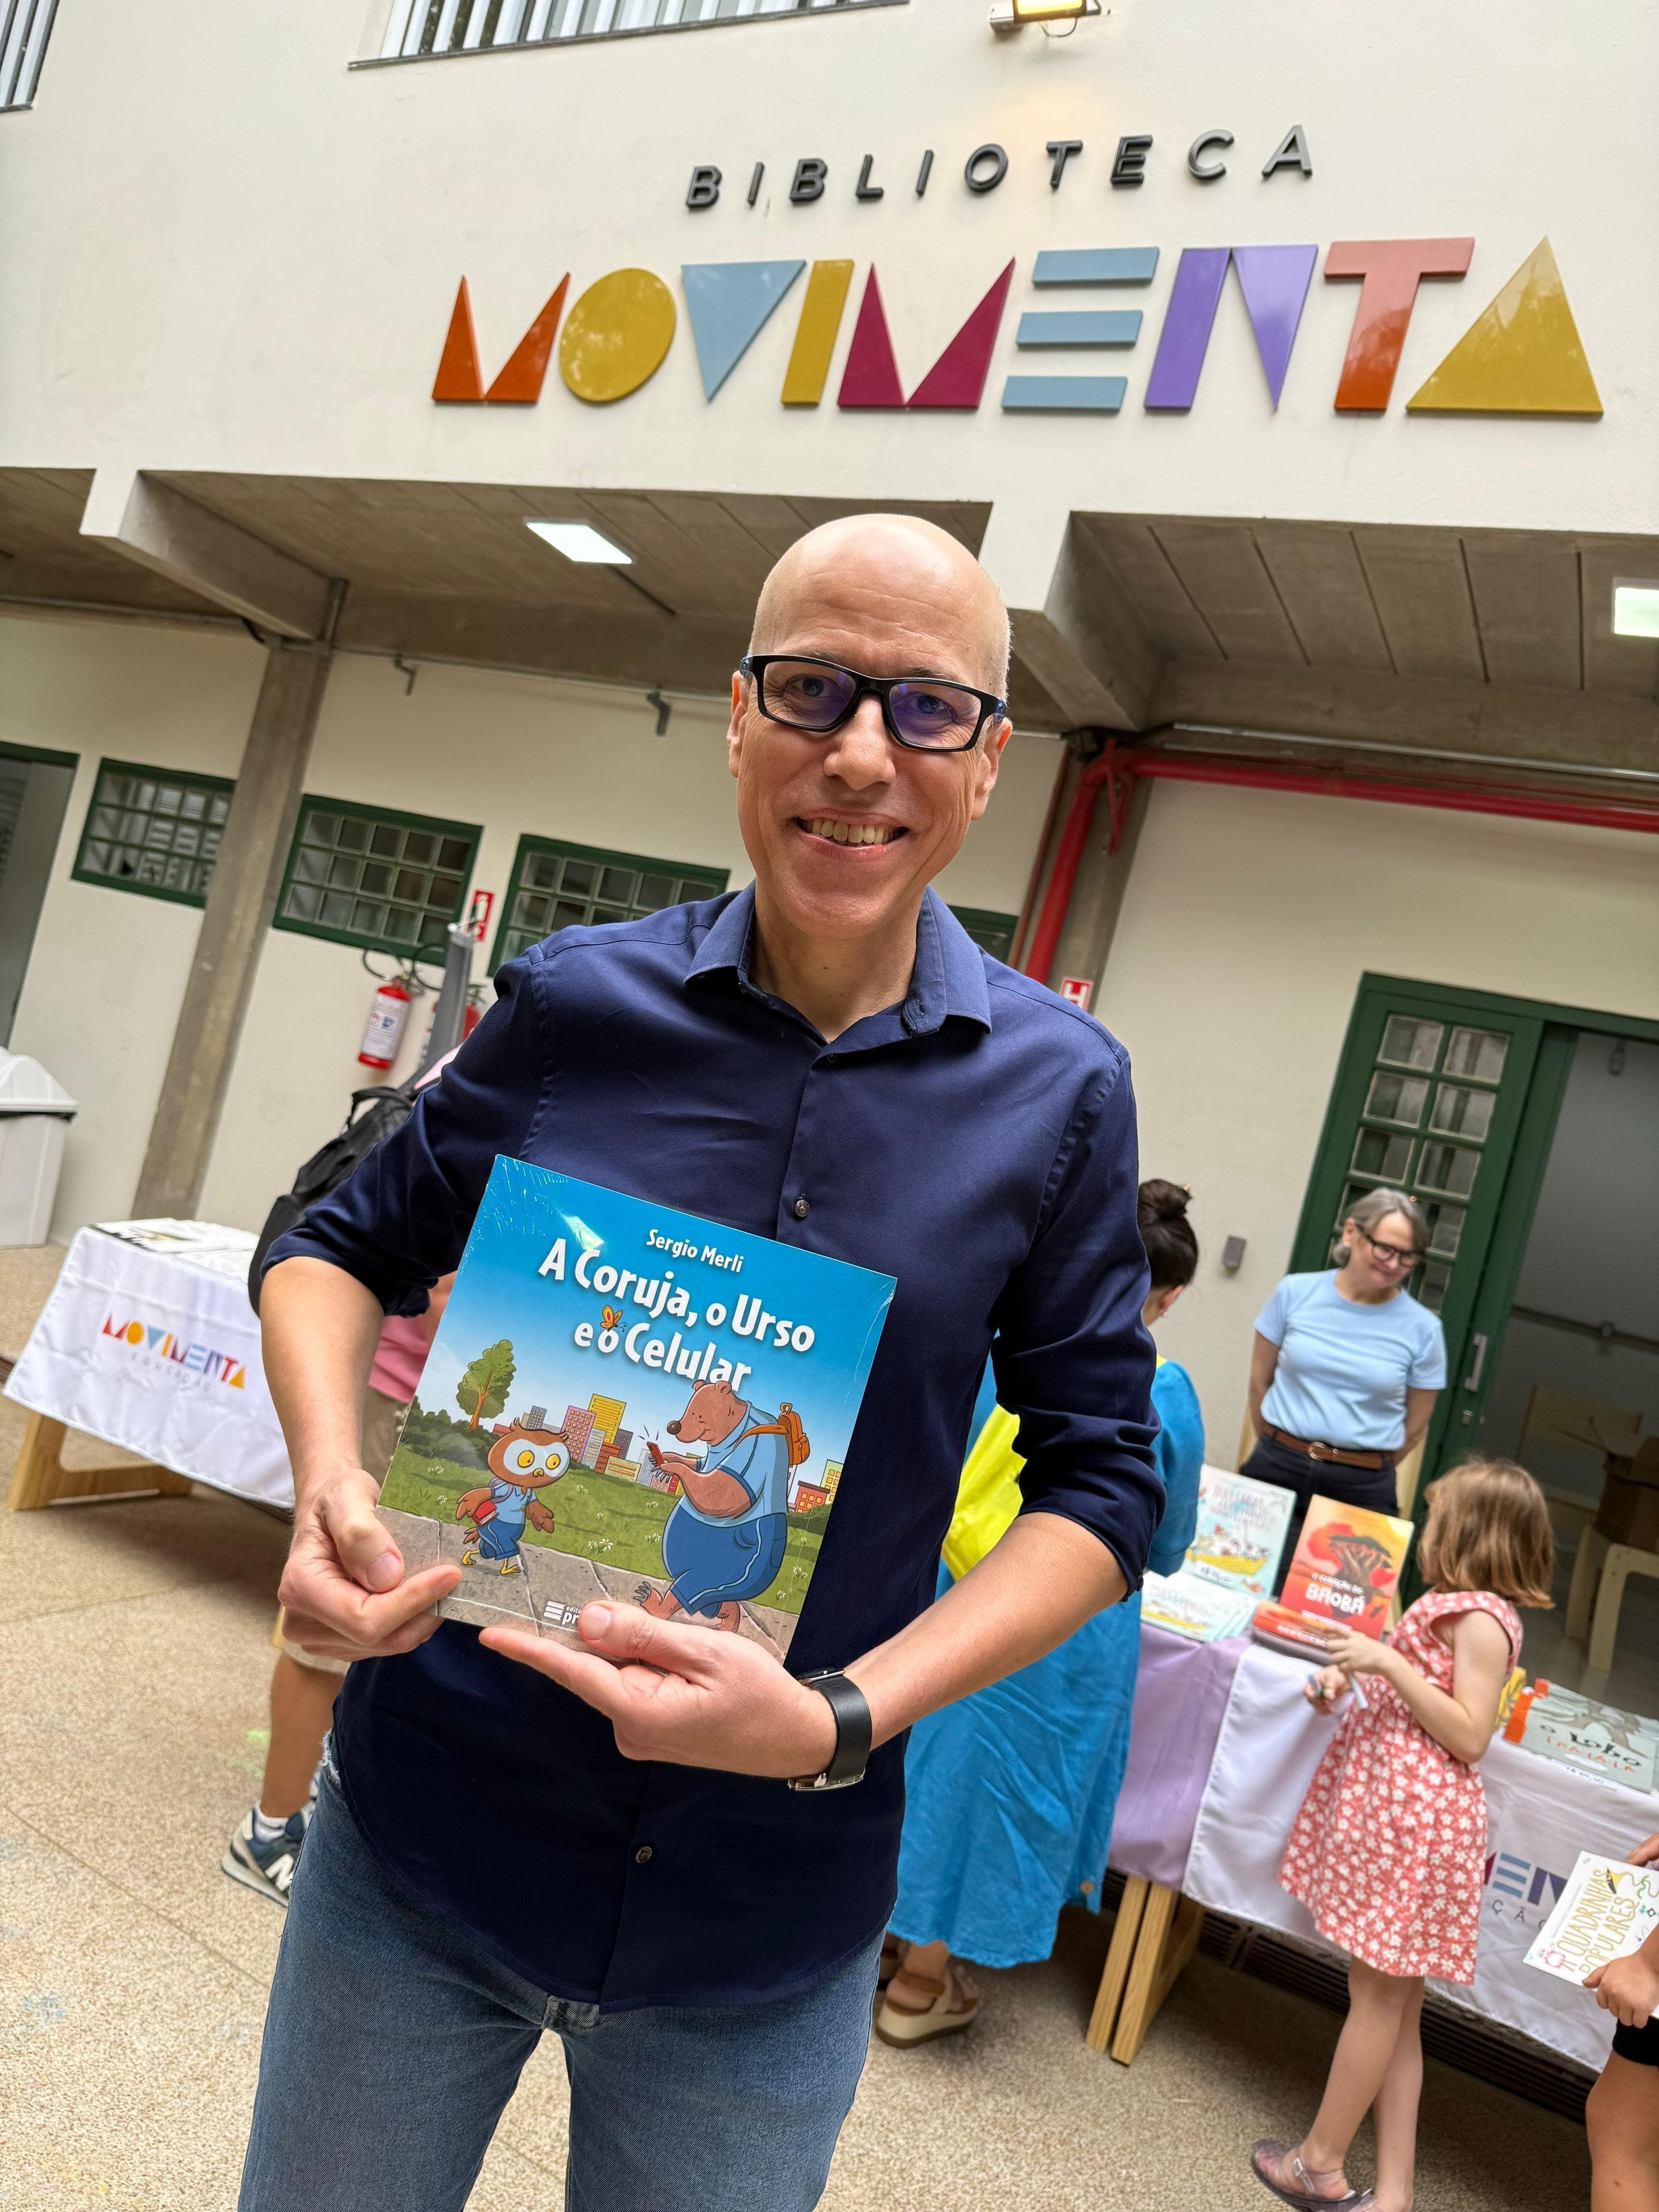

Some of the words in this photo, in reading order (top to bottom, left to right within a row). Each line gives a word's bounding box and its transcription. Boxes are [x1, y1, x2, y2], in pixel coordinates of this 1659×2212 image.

[686, 124, 1313, 211] BIBLIOTECA
[431, 236, 1603, 417] MOVIMENTA
[646, 1228, 698, 1258] Sergio
[700, 1244, 744, 1273] Merli
[538, 1238, 566, 1280] A
[574, 1249, 698, 1328] Coruja,
[706, 1302, 726, 1326] o
[732, 1294, 816, 1352] Urso
[102, 1313, 247, 1390] MOVIMENTA
[574, 1321, 593, 1346] e
[597, 1329, 618, 1353] o
[625, 1322, 752, 1392] Celular
[1305, 1582, 1366, 1616] BAOBÁ
[1570, 1731, 1641, 1767] Lobo
[1557, 1869, 1613, 1957] QUADRINHAS
